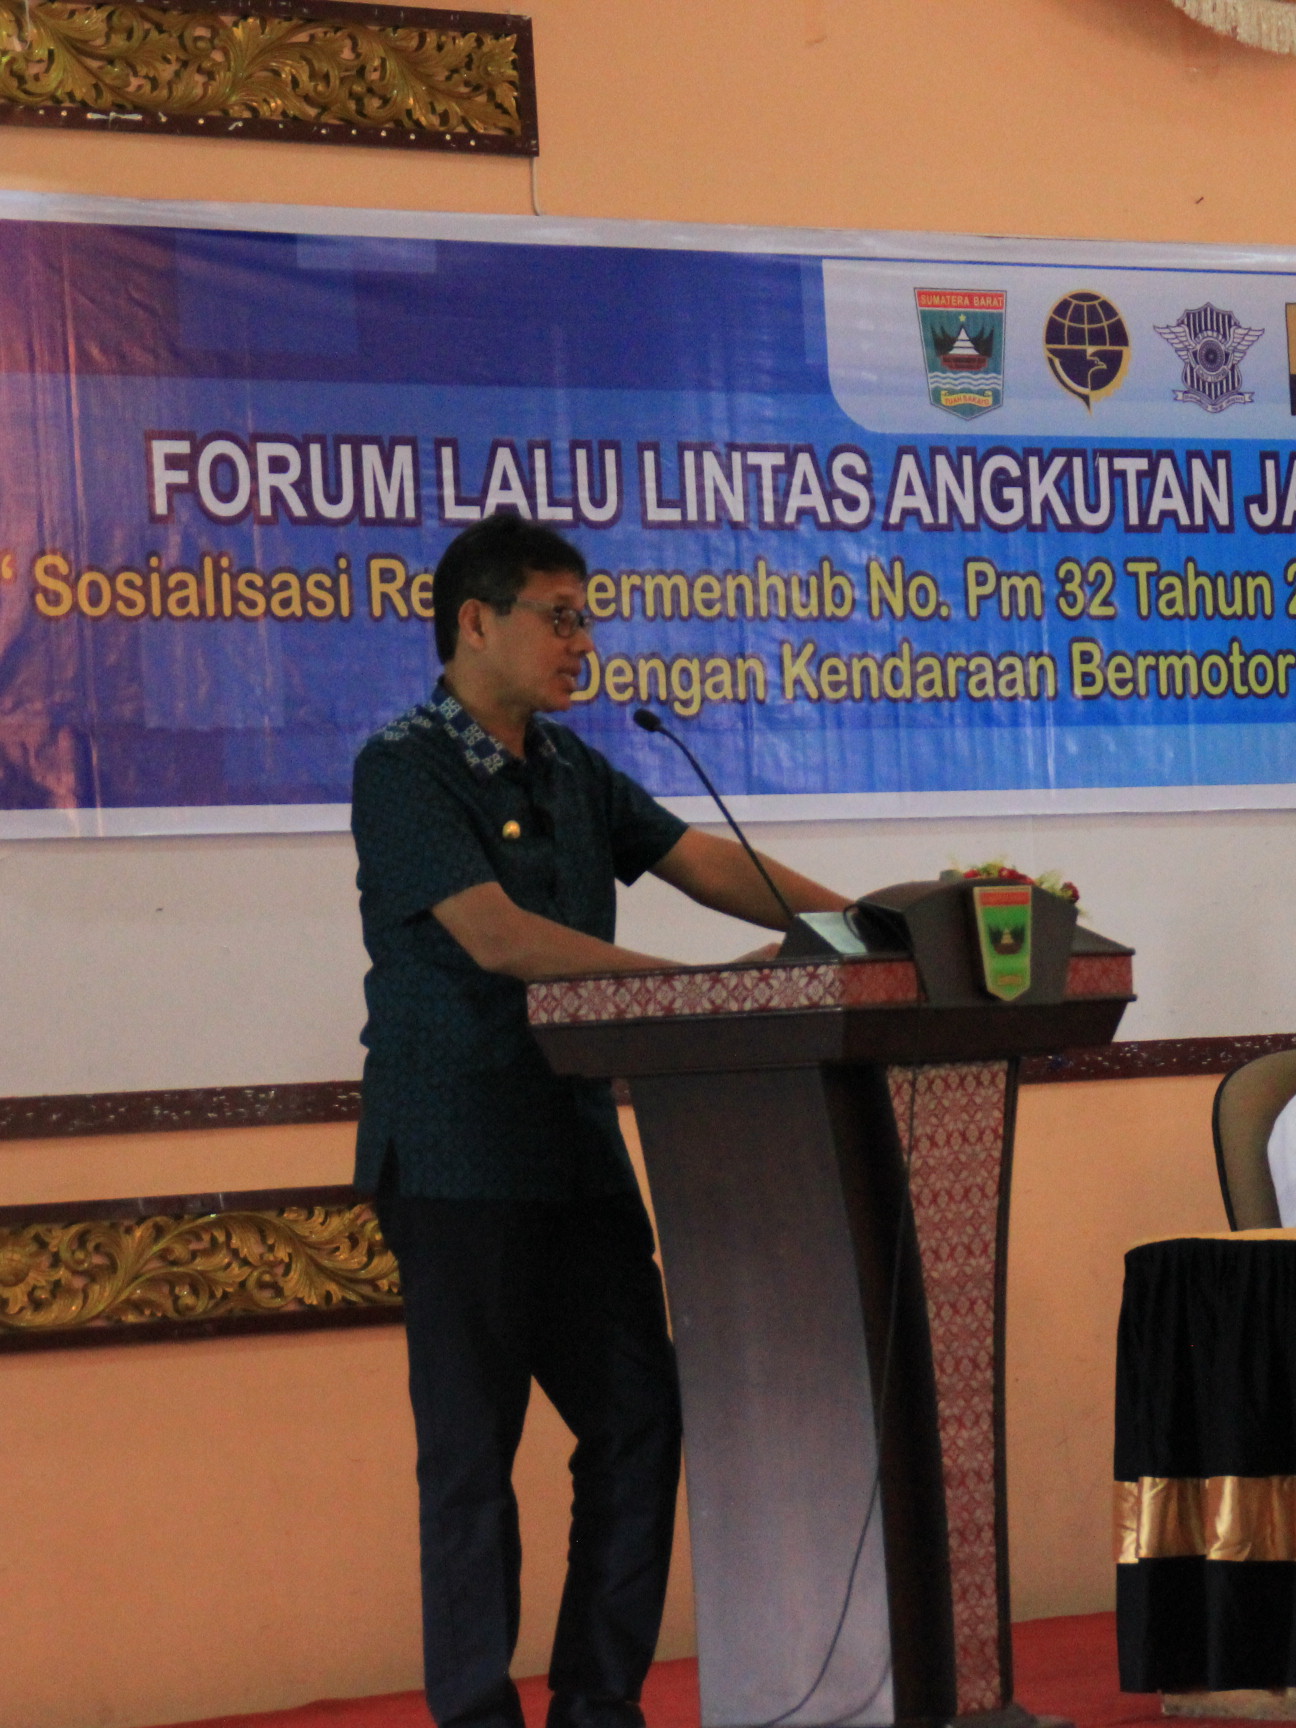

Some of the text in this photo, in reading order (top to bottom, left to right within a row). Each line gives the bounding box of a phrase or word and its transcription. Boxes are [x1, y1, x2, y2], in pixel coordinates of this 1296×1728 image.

[920, 294, 1003, 307] SUMATERA BARAT
[149, 439, 417, 520] FORUM
[441, 446, 619, 522] LALU
[643, 449, 869, 525] LINTAS
[888, 452, 1233, 527] ANGKUTAN
[33, 553, 351, 619] Sosialisasi
[586, 558, 855, 619] ermenhub
[867, 560, 949, 619] No.
[966, 560, 1044, 619] Pm
[1056, 560, 1117, 618] 32
[1126, 560, 1274, 618] Tahun
[780, 641, 1057, 700] Kendaraan
[1070, 640, 1296, 697] Bermotor
